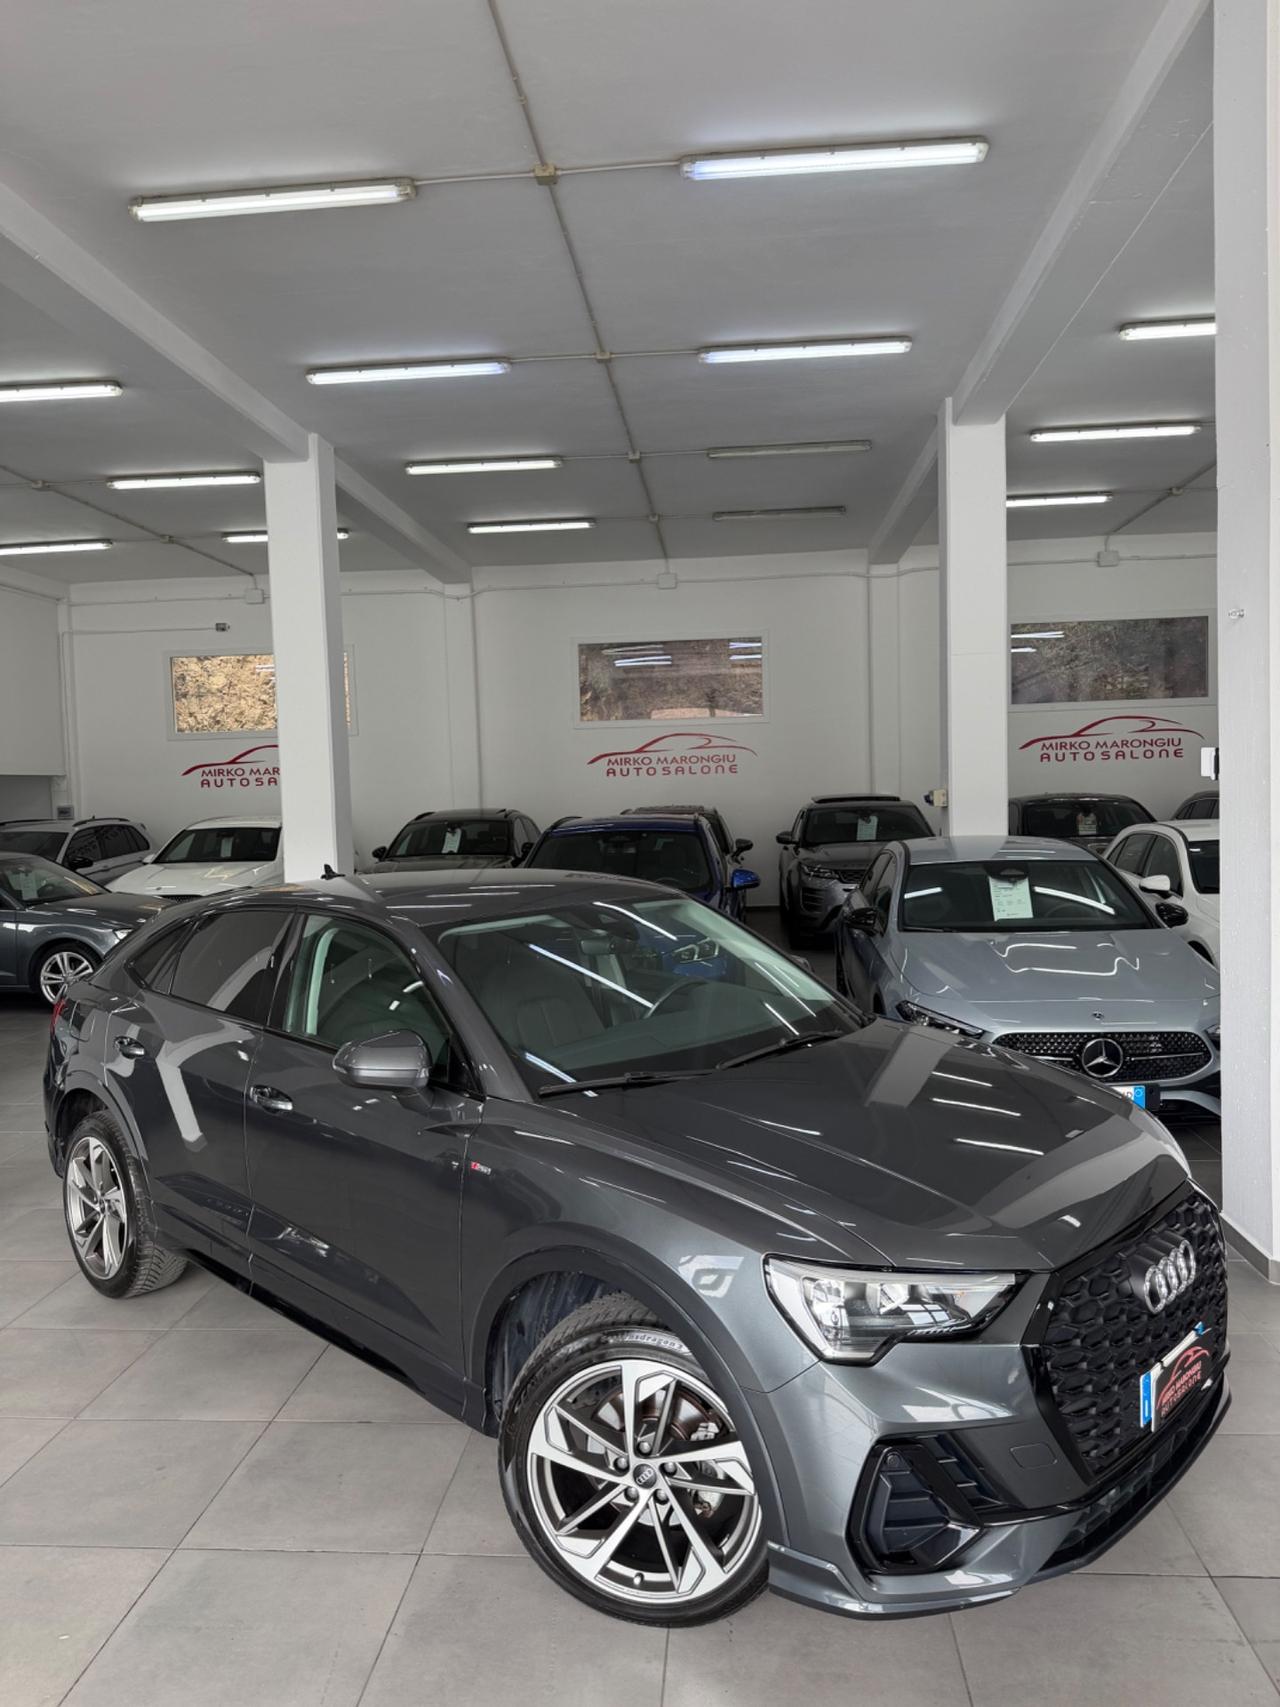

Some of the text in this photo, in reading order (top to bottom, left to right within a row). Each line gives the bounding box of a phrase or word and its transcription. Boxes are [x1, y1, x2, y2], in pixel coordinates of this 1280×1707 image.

[1041, 737, 1182, 751] MIRKO MARONGIU
[607, 754, 736, 767] MIRKO MARONGIU
[1039, 748, 1185, 763] AUTOSALONE
[201, 768, 245, 778] MIRKO
[606, 764, 738, 777] AUTOSALONE
[200, 777, 278, 788] AUTOSA
